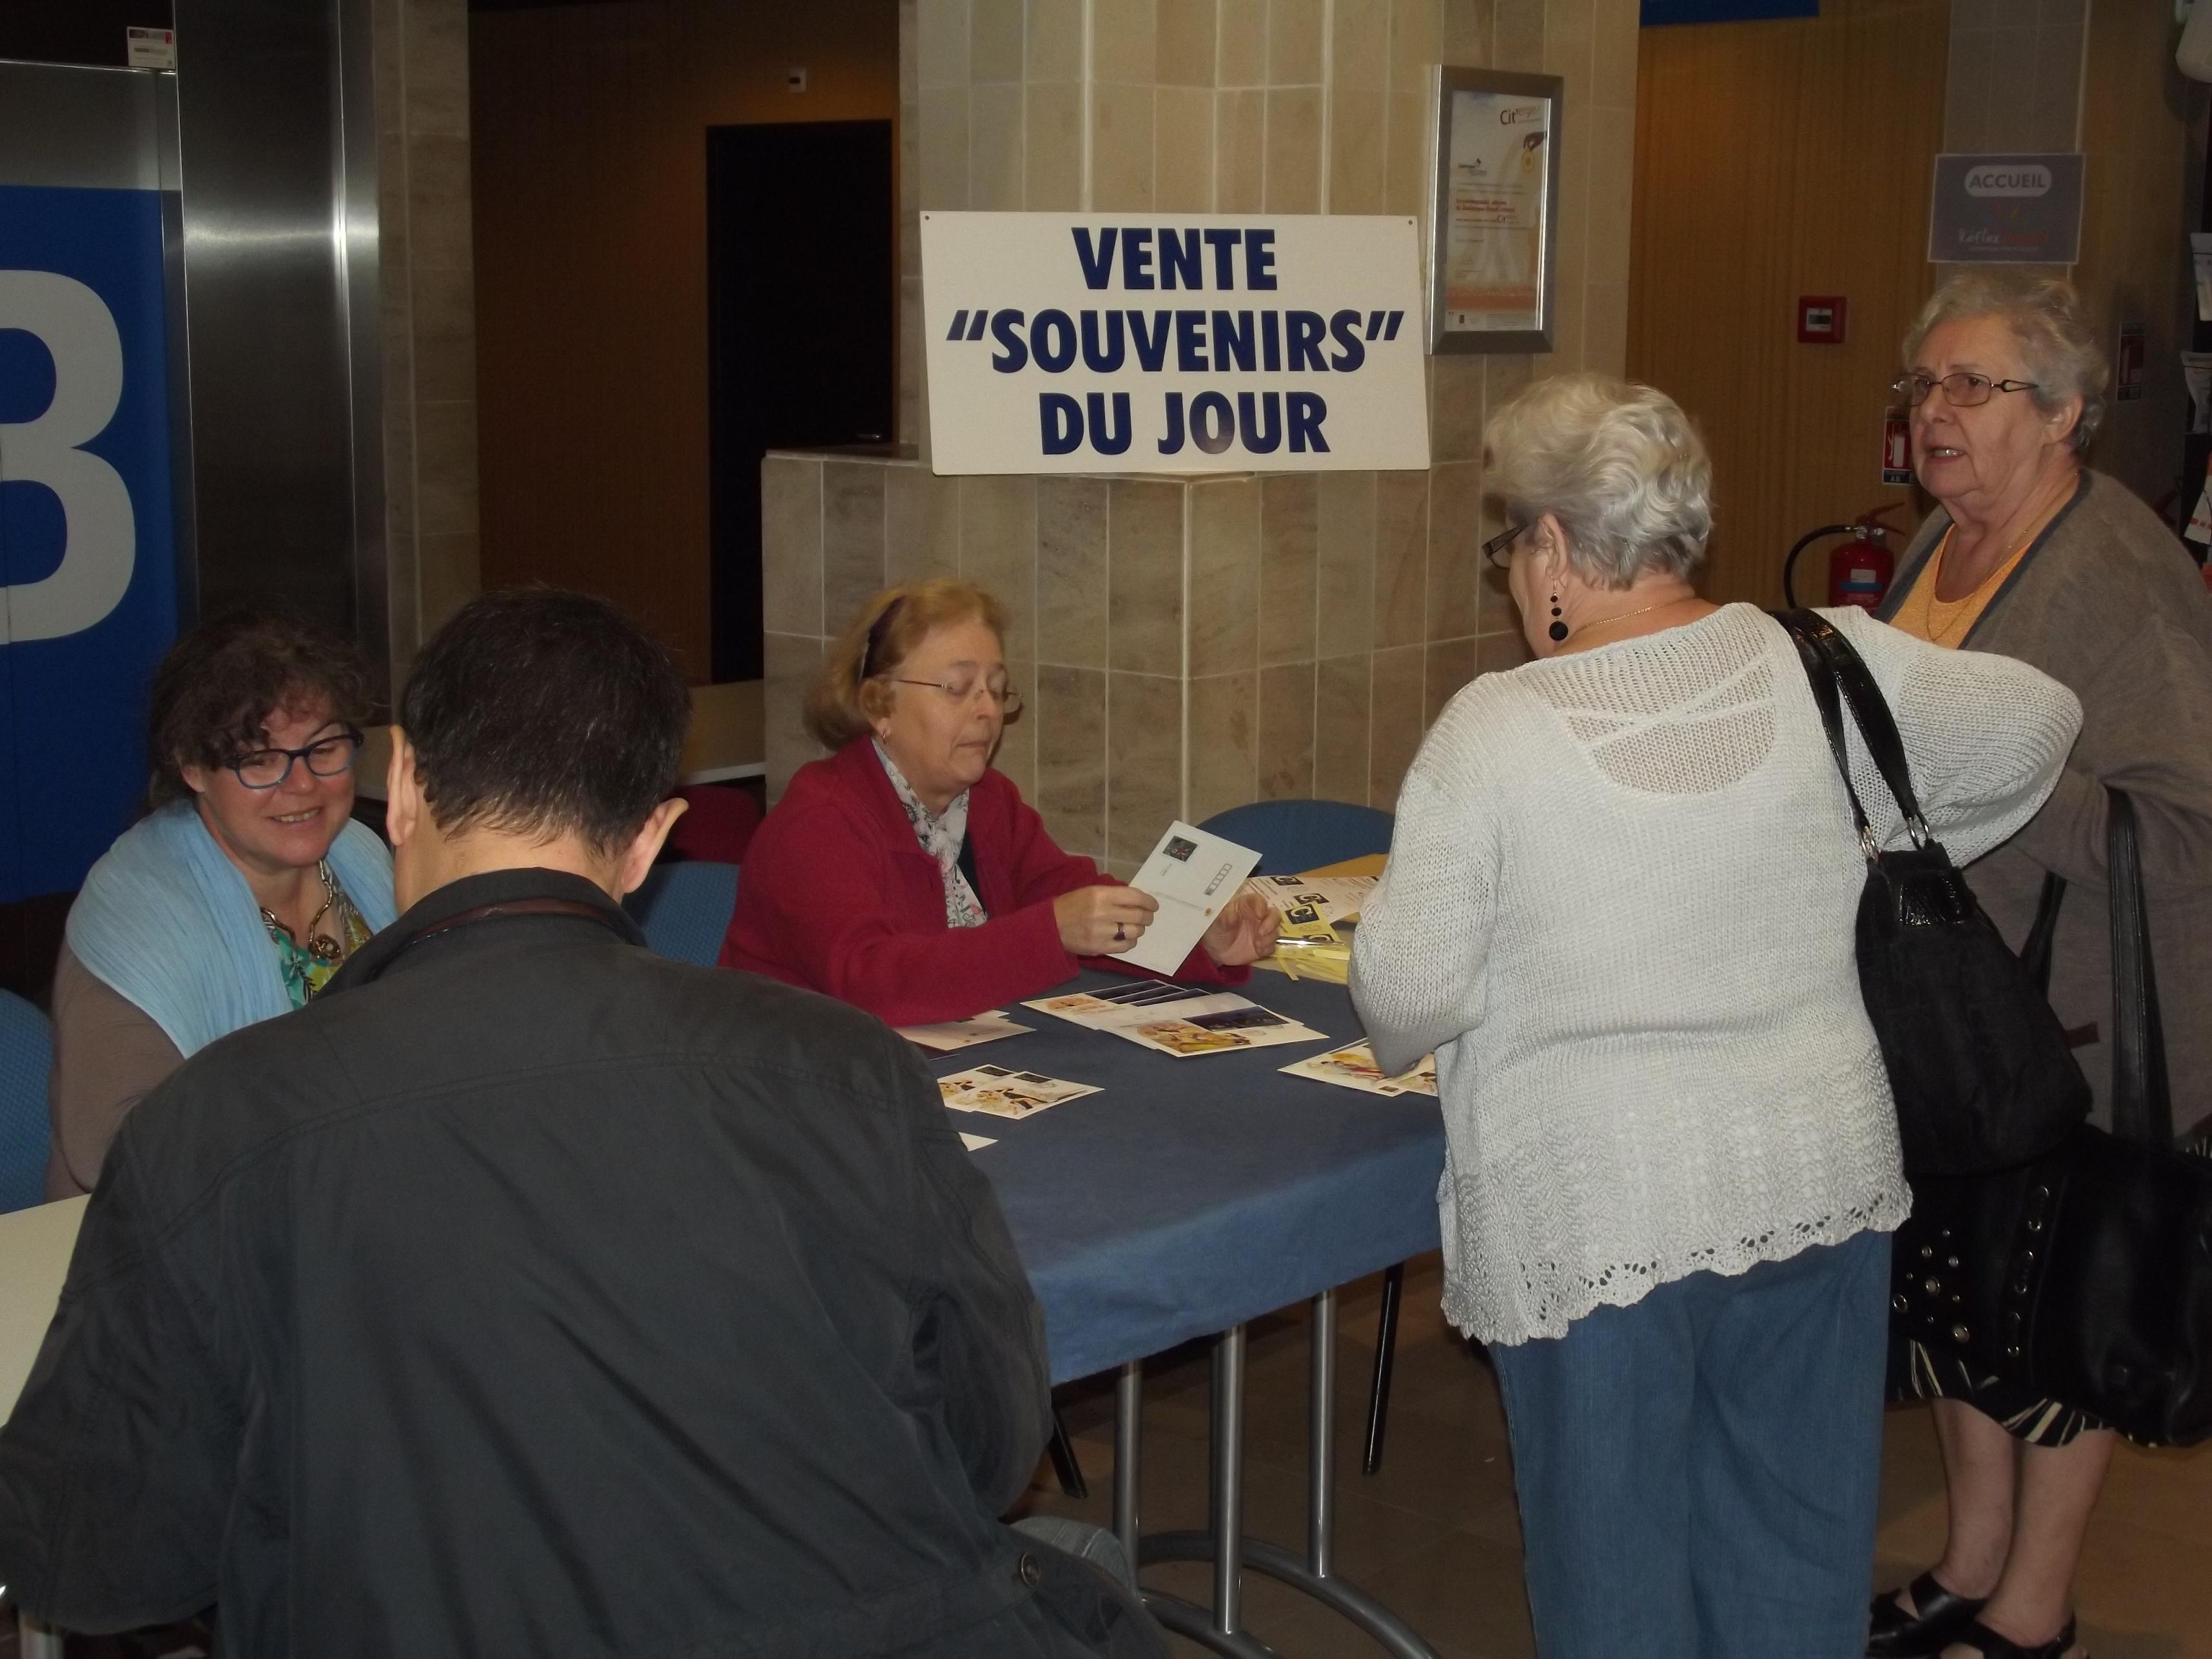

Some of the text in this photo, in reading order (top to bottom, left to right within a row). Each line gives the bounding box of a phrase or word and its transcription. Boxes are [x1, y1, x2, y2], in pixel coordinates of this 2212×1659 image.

[1968, 173, 2047, 189] ACCUEIL
[1070, 226, 1278, 291] VENTE
[945, 308, 1405, 373] "SOUVENIRS"
[1038, 390, 1331, 456] DU JOUR
